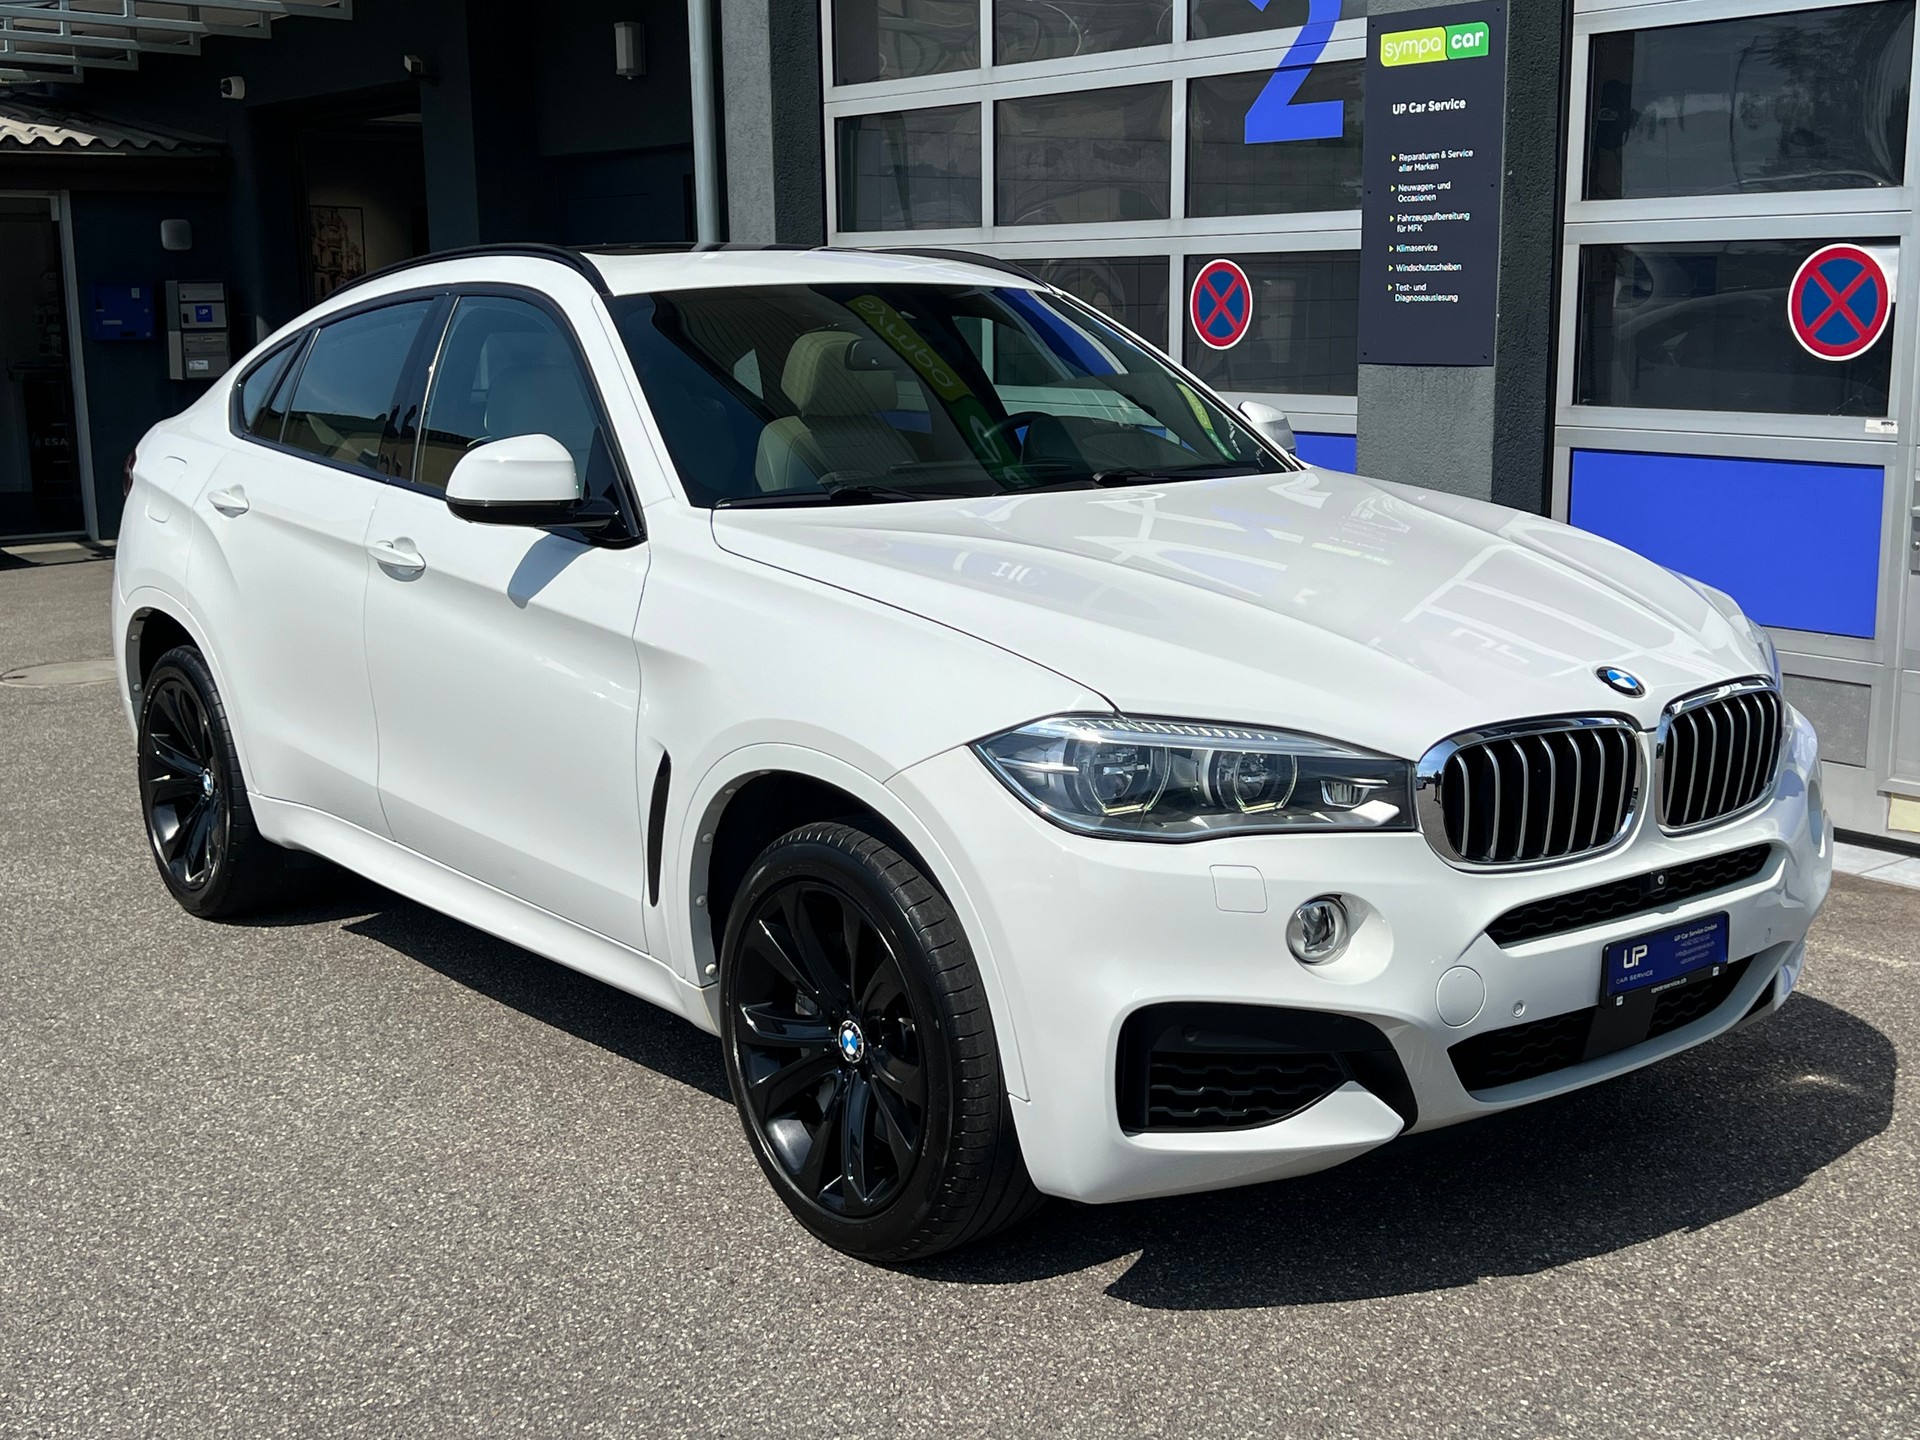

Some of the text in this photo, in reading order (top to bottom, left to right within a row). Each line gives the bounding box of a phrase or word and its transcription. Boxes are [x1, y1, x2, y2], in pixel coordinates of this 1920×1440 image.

[1384, 31, 1484, 61] sympa car
[1244, 0, 1344, 145] 2
[1392, 98, 1466, 115] UP Car Service
[1398, 149, 1474, 162] Reparaturen & Service
[1398, 162, 1439, 172] aller Marken
[1398, 181, 1451, 192] Neuwagen- und
[1397, 193, 1437, 203] Occasionen
[1397, 212, 1471, 223] Fahrzeugaufbereitung
[1396, 224, 1423, 233] für MFK
[1396, 243, 1439, 253] Klimaservice
[1395, 262, 1462, 272] Windschutzscheiben
[1395, 283, 1427, 292] Test- und
[1394, 293, 1459, 303] Diagnoseauslesung
[1623, 944, 1648, 969] UP
[1629, 969, 1654, 981] SERVICE
